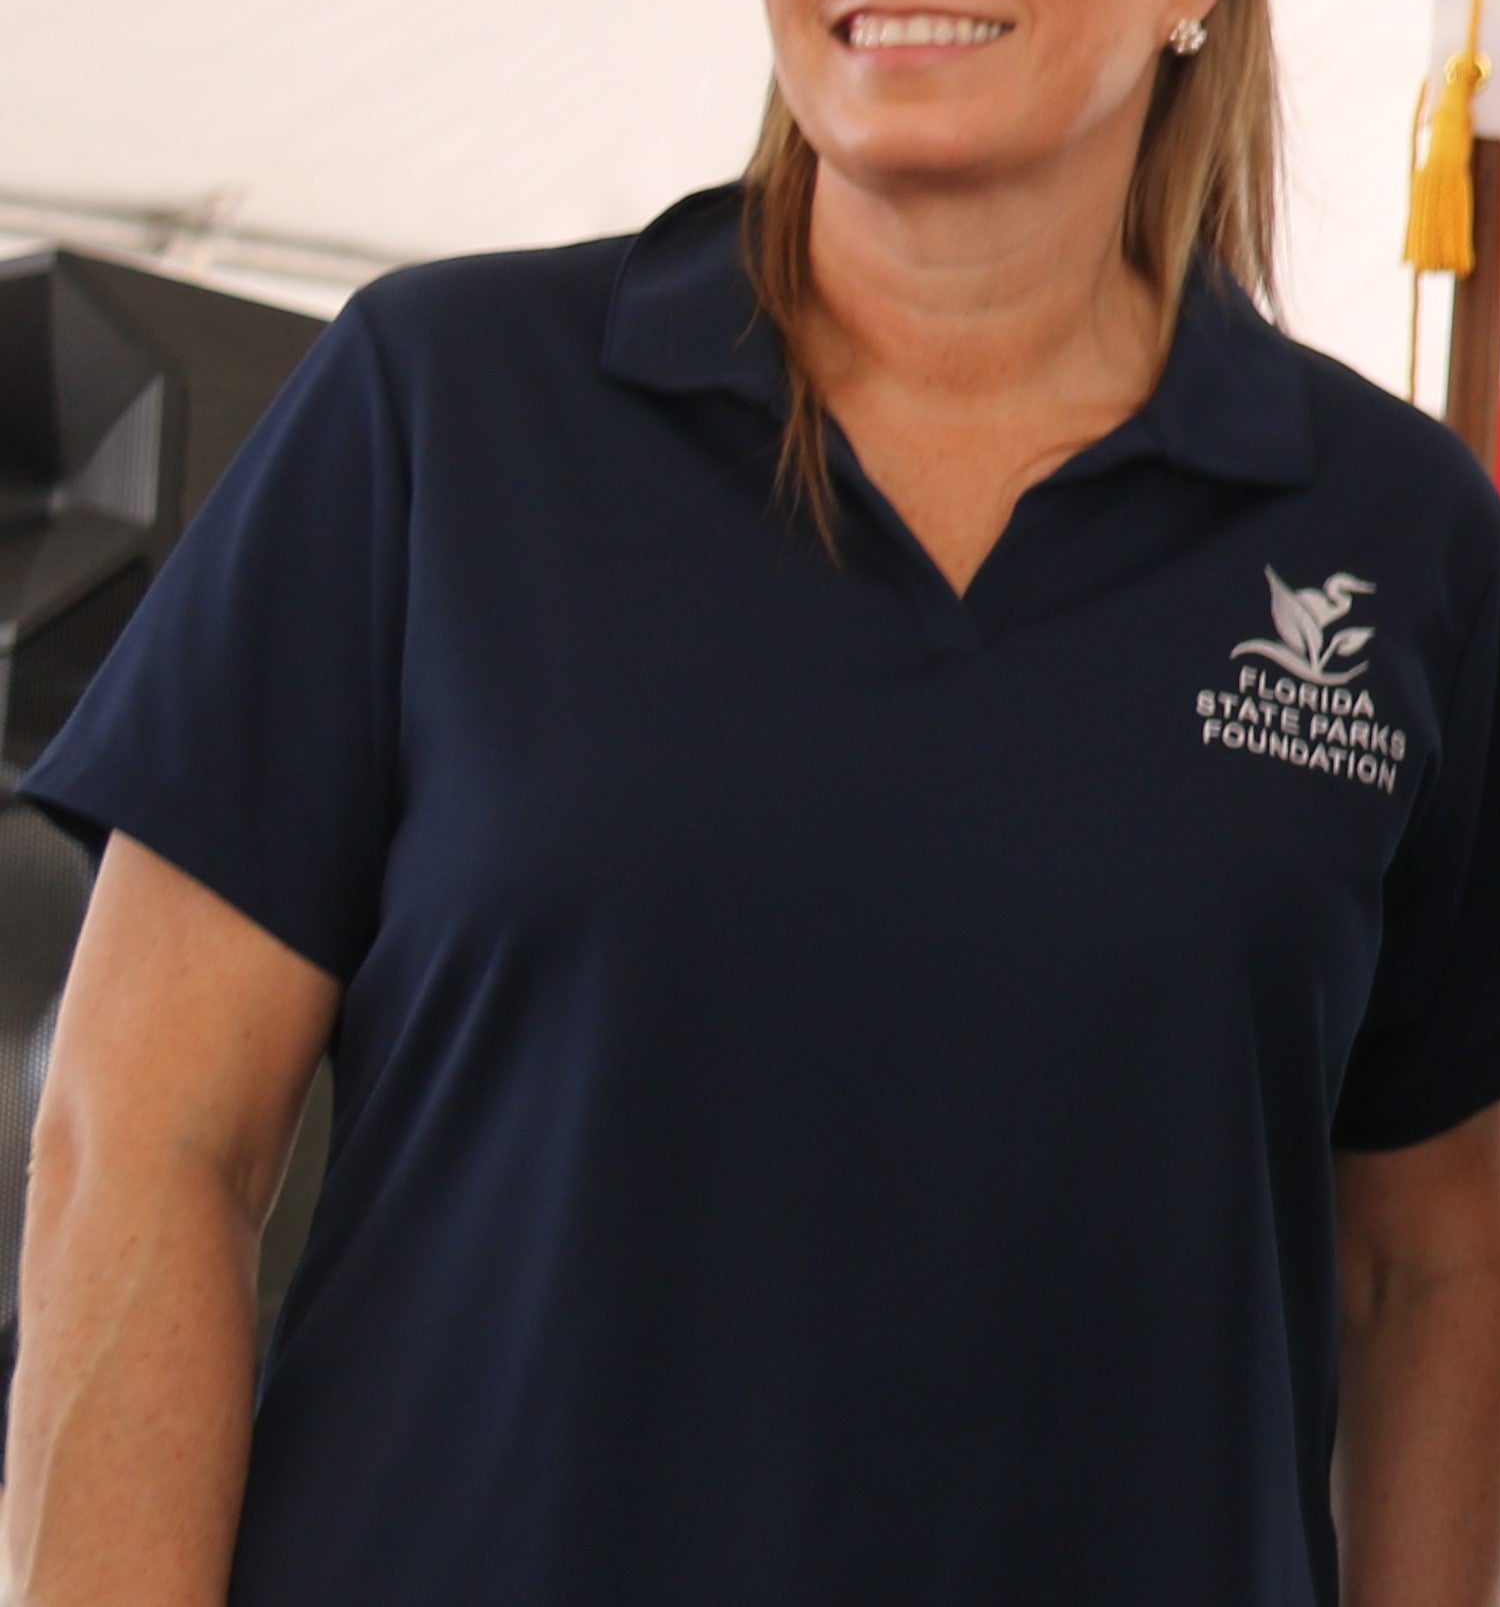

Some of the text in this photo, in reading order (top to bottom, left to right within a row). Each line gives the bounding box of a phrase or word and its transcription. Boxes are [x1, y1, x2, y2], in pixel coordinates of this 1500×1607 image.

[1196, 689, 1407, 762] STATE PARKS
[1239, 665, 1375, 719] FLORIDA
[1202, 717, 1398, 795] FOUNDATION
